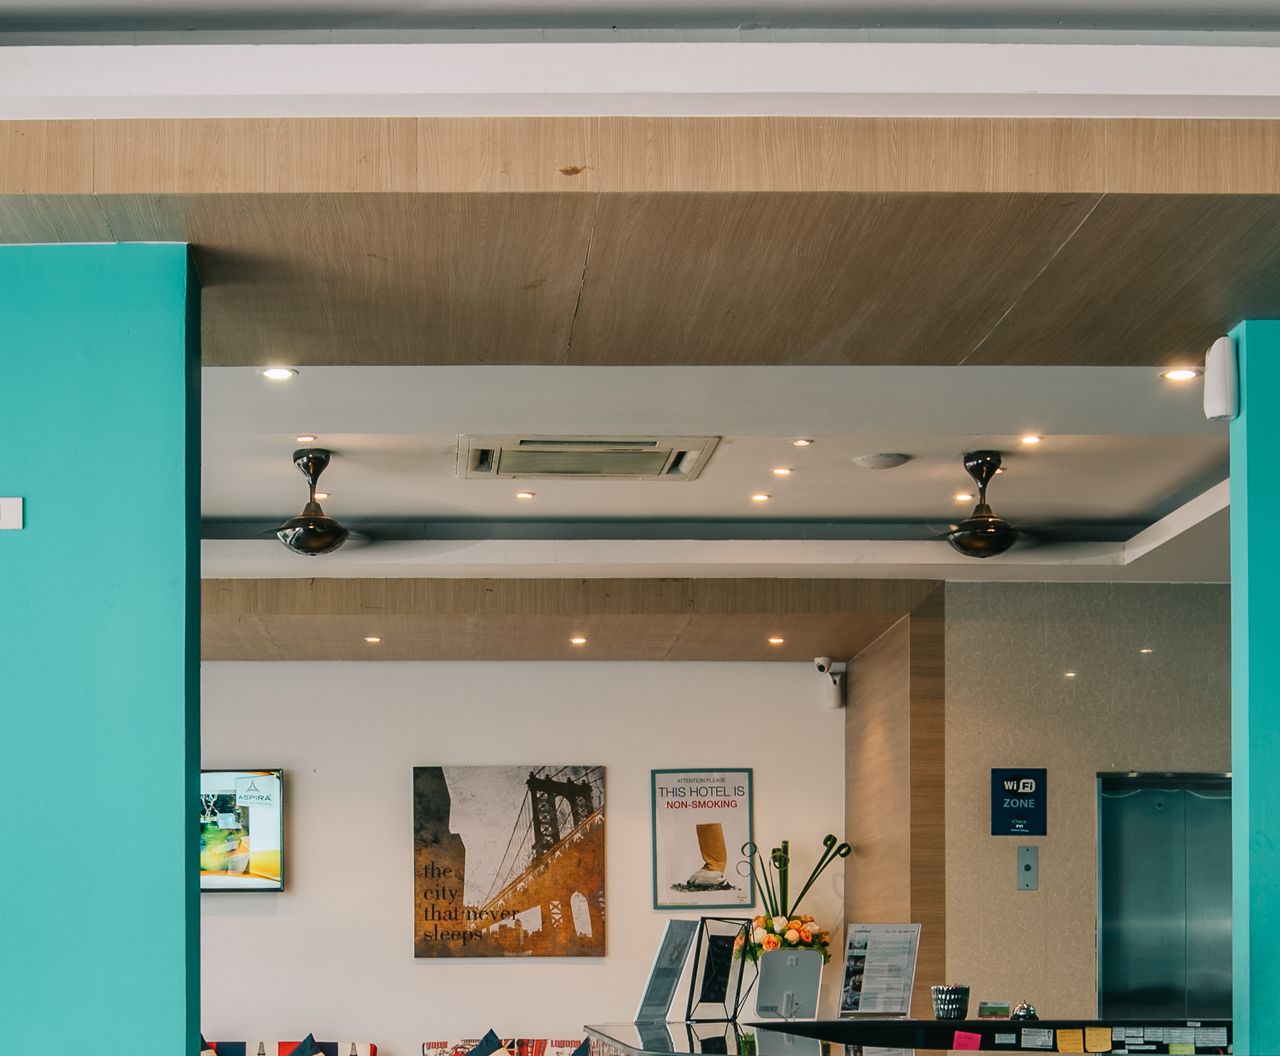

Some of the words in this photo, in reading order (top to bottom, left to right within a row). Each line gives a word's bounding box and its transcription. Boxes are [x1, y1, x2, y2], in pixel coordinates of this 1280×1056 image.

[658, 787, 686, 797] THIS
[689, 786, 730, 797] HOTEL
[733, 786, 745, 796] IS
[666, 800, 738, 809] NON-SMOKING
[1003, 799, 1035, 808] ZONE
[424, 861, 453, 879] the
[424, 883, 458, 905] city
[424, 904, 459, 921] that
[467, 910, 520, 921] never
[424, 924, 483, 946] sleeps
